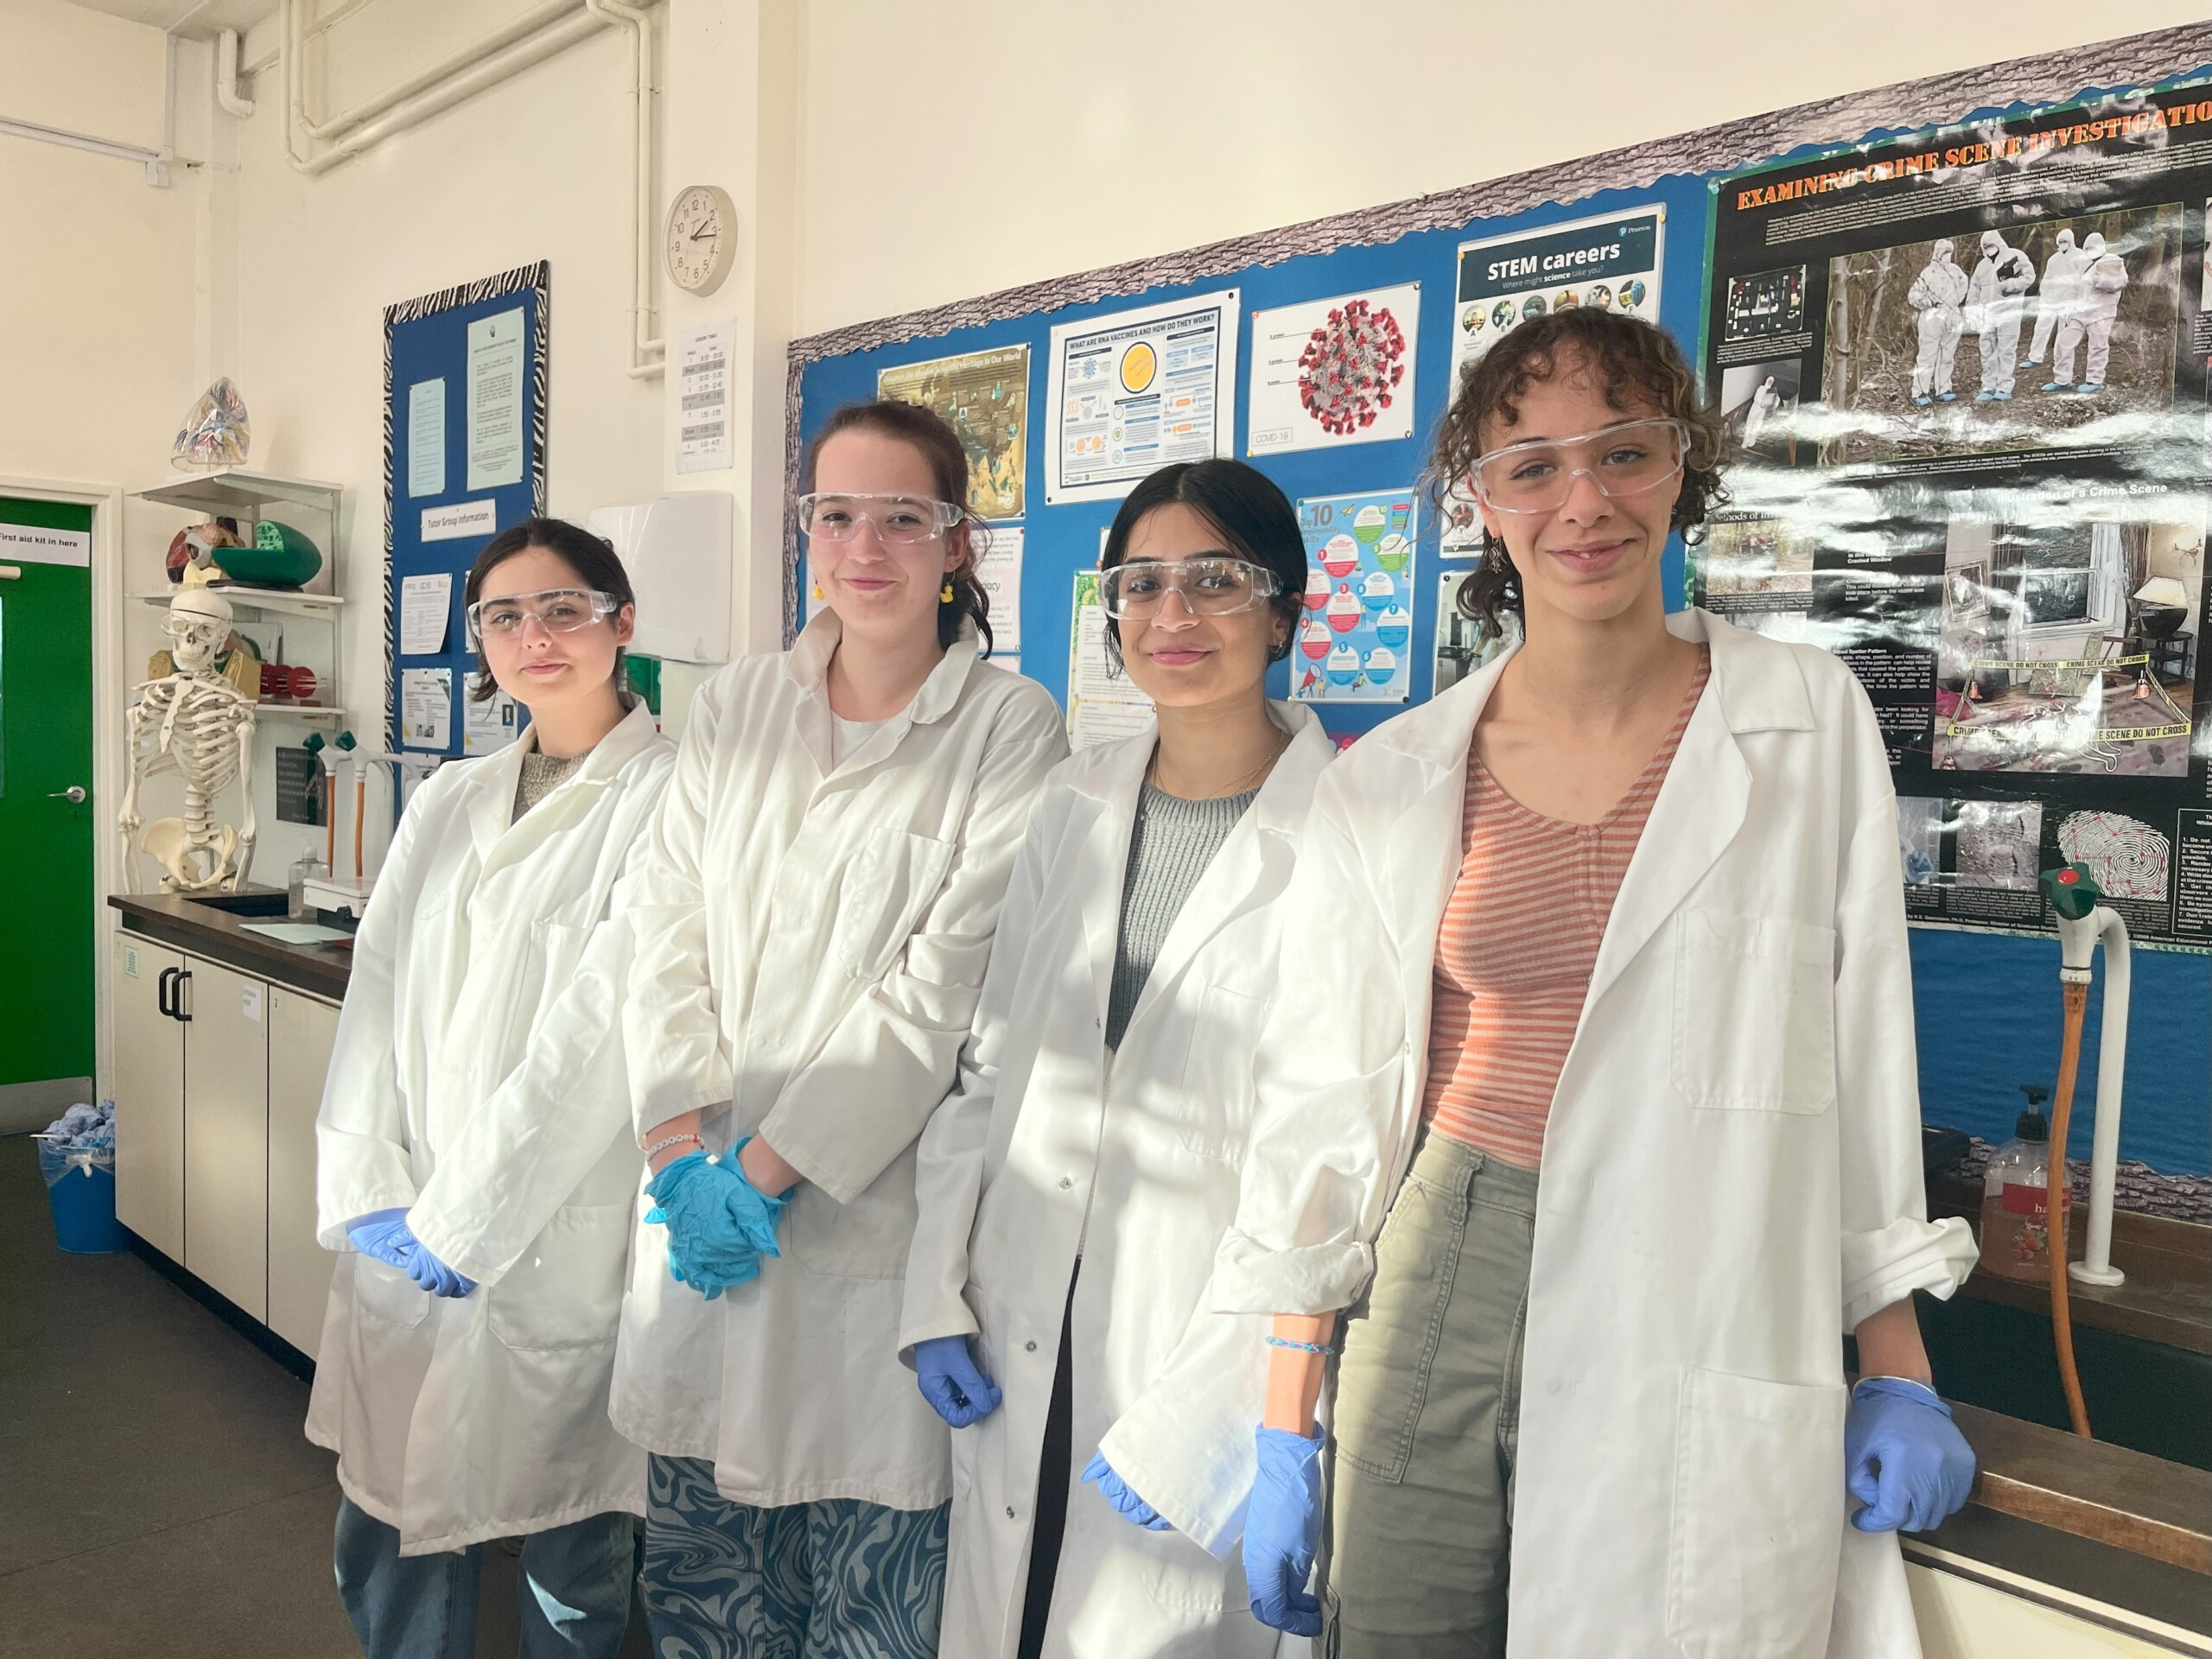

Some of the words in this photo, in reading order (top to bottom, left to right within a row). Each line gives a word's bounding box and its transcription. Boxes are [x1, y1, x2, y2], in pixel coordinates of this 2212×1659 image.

[1738, 167, 1858, 211] EXAMINING
[1864, 151, 1940, 183] CRIME
[1945, 136, 2022, 168] SCENE
[691, 199, 699, 211] 12
[703, 200, 707, 211] 1
[683, 207, 690, 219] 11
[709, 209, 715, 221] 2
[677, 222, 685, 233] 10
[1628, 225, 1651, 234] Pearson
[675, 241, 680, 252] 9
[709, 245, 715, 254] 4
[677, 257, 683, 268] 8
[703, 259, 709, 271] 5
[1487, 256, 1537, 281] STEM
[1542, 243, 1621, 270] careers
[685, 266, 690, 277] 7
[694, 268, 699, 279] 6
[1502, 281, 1523, 290] Where
[1524, 276, 1543, 287] might
[1543, 272, 1571, 283] science
[1572, 269, 1587, 278] take
[1587, 264, 1605, 277] you?
[1070, 340, 1086, 350] WHAT
[1086, 338, 1097, 346] ARE
[1098, 335, 1109, 344] RNA
[1110, 330, 1138, 341] VACCINES
[1140, 327, 1152, 335] AND
[1153, 323, 1166, 333] HOW
[1167, 322, 1176, 331] DO
[1177, 319, 1192, 328] THEY
[1193, 314, 1215, 325] WORK?
[960, 357, 983, 370] Heritage
[991, 353, 1002, 364] Our
[1003, 350, 1022, 361] World
[1255, 432, 1288, 443] COVID-19
[1997, 490, 2060, 503] Illustration
[2063, 488, 2075, 499] of
[2089, 486, 2126, 497] Crime
[2129, 484, 2168, 495] Scene
[428, 519, 442, 528] Tutor
[442, 517, 458, 527] Group
[459, 512, 490, 524] Information
[1310, 504, 1333, 526] 10
[1717, 512, 1747, 522] ethods
[1301, 518, 1313, 528] Top
[35, 536, 46, 544] kit
[59, 539, 78, 548] here
[2106, 729, 2131, 741] SCENE
[2133, 728, 2143, 738] DO
[2145, 727, 2161, 737] NOT
[2163, 724, 2187, 735] CROSS
[275, 998, 278, 1008] 2
